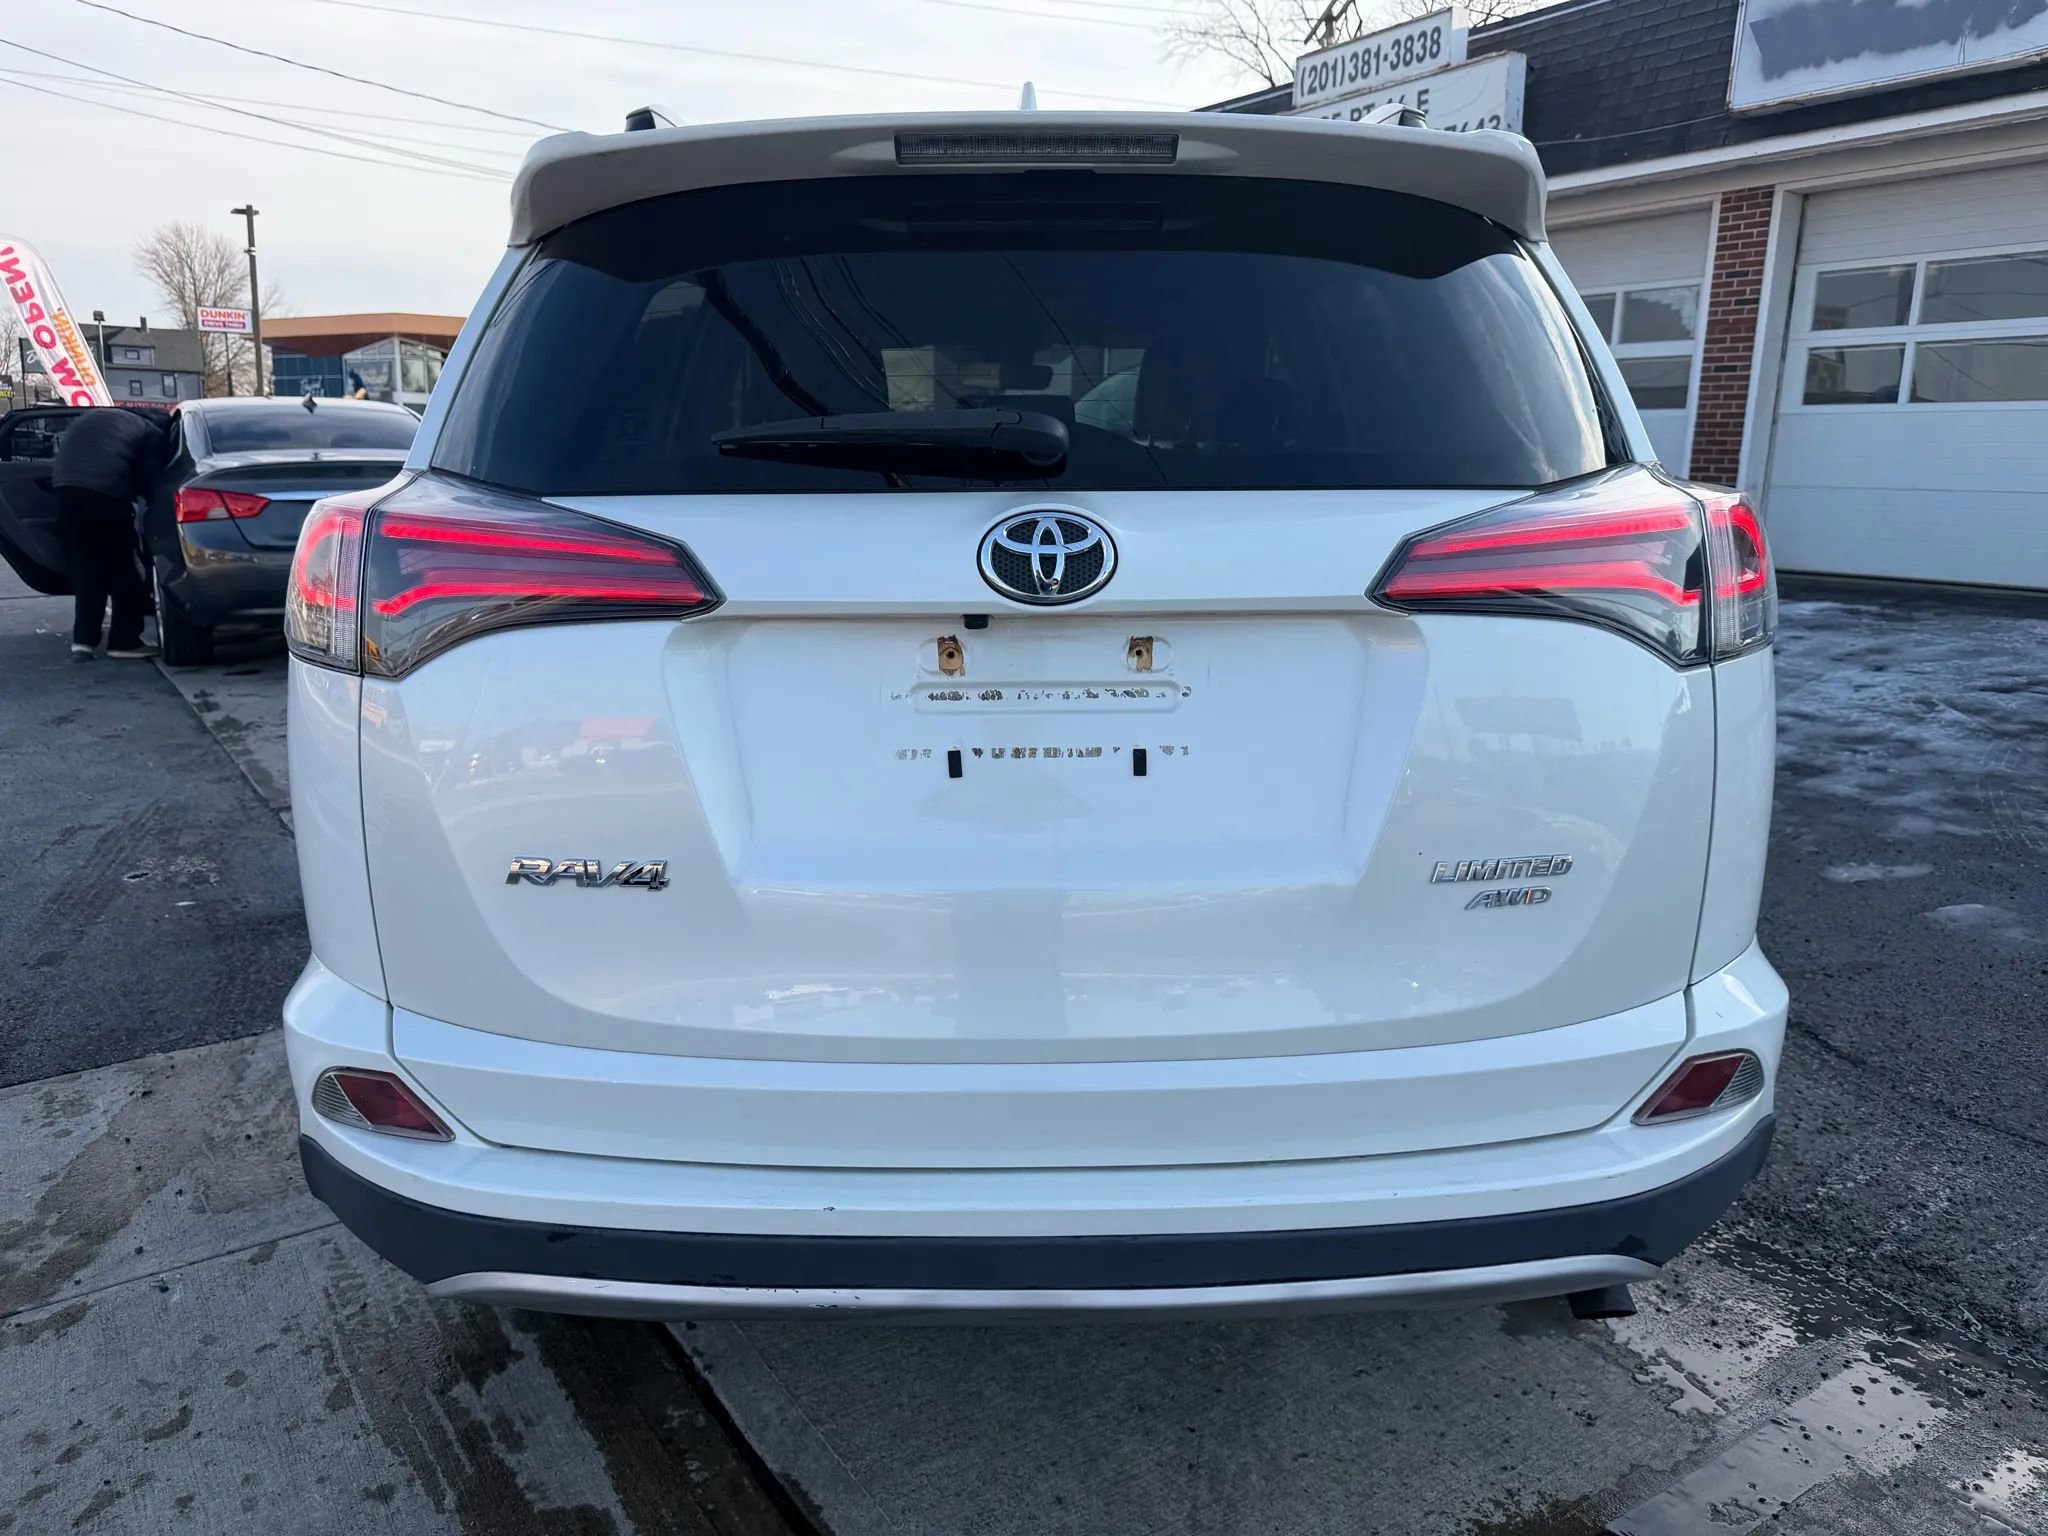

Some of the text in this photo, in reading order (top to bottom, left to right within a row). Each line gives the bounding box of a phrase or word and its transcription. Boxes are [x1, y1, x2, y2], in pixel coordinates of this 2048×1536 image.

[1301, 25, 1442, 97] (201)381-3838
[505, 855, 672, 893] RAV4
[1430, 853, 1574, 884] LIMITED
[1464, 885, 1552, 911] AWD
